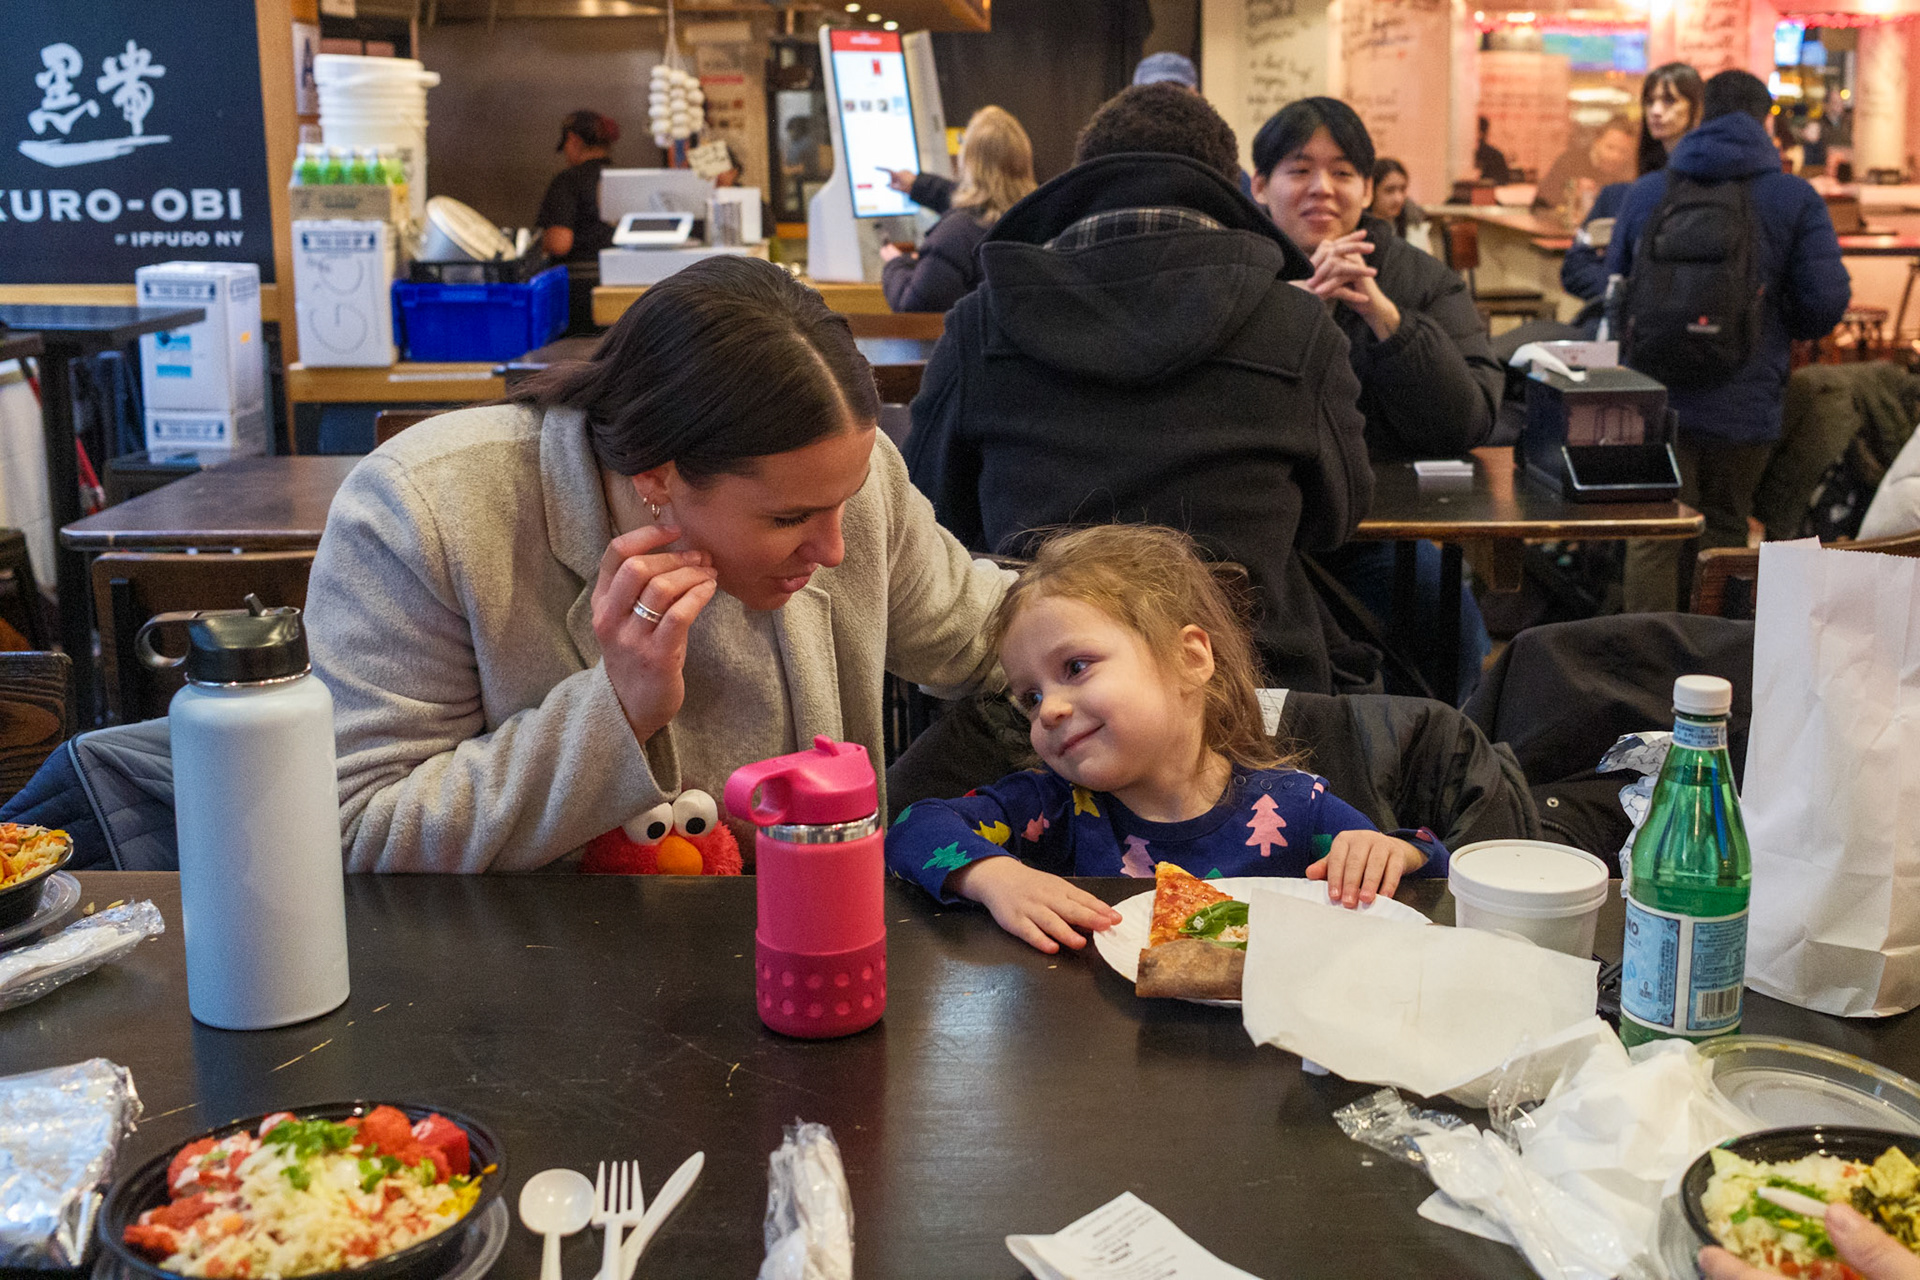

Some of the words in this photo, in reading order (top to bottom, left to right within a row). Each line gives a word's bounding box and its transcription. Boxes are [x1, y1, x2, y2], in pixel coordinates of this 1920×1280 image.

[0, 188, 243, 222] URO-OBI
[130, 231, 210, 247] IPPUDO
[214, 231, 245, 247] NY
